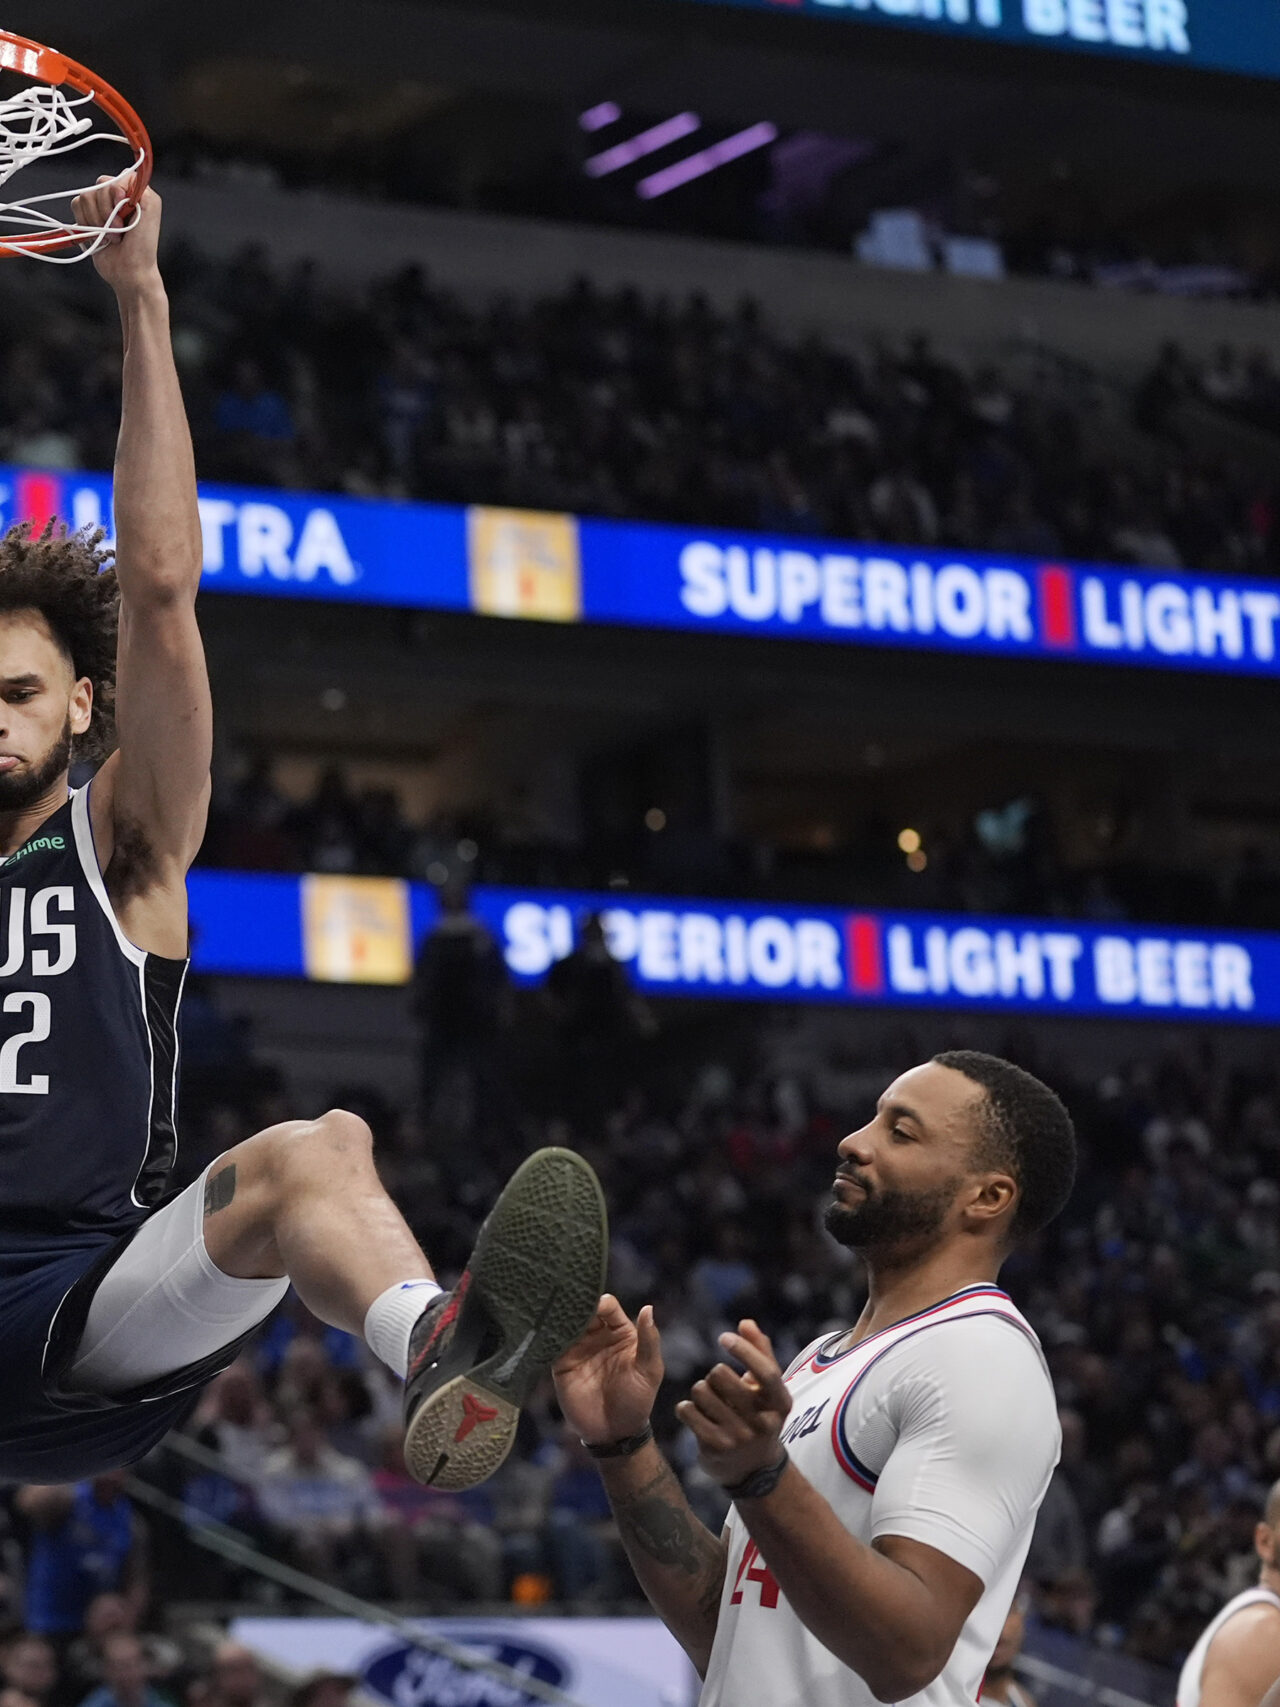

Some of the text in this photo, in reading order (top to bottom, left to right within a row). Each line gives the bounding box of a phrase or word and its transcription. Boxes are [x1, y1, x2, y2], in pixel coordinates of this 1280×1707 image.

[1022, 0, 1190, 53] BEER
[72, 489, 356, 585] UTRA
[679, 541, 1280, 661] SUPERIOR LIGHT
[888, 924, 1082, 1000] LIGHT
[1092, 936, 1255, 1010] BEER
